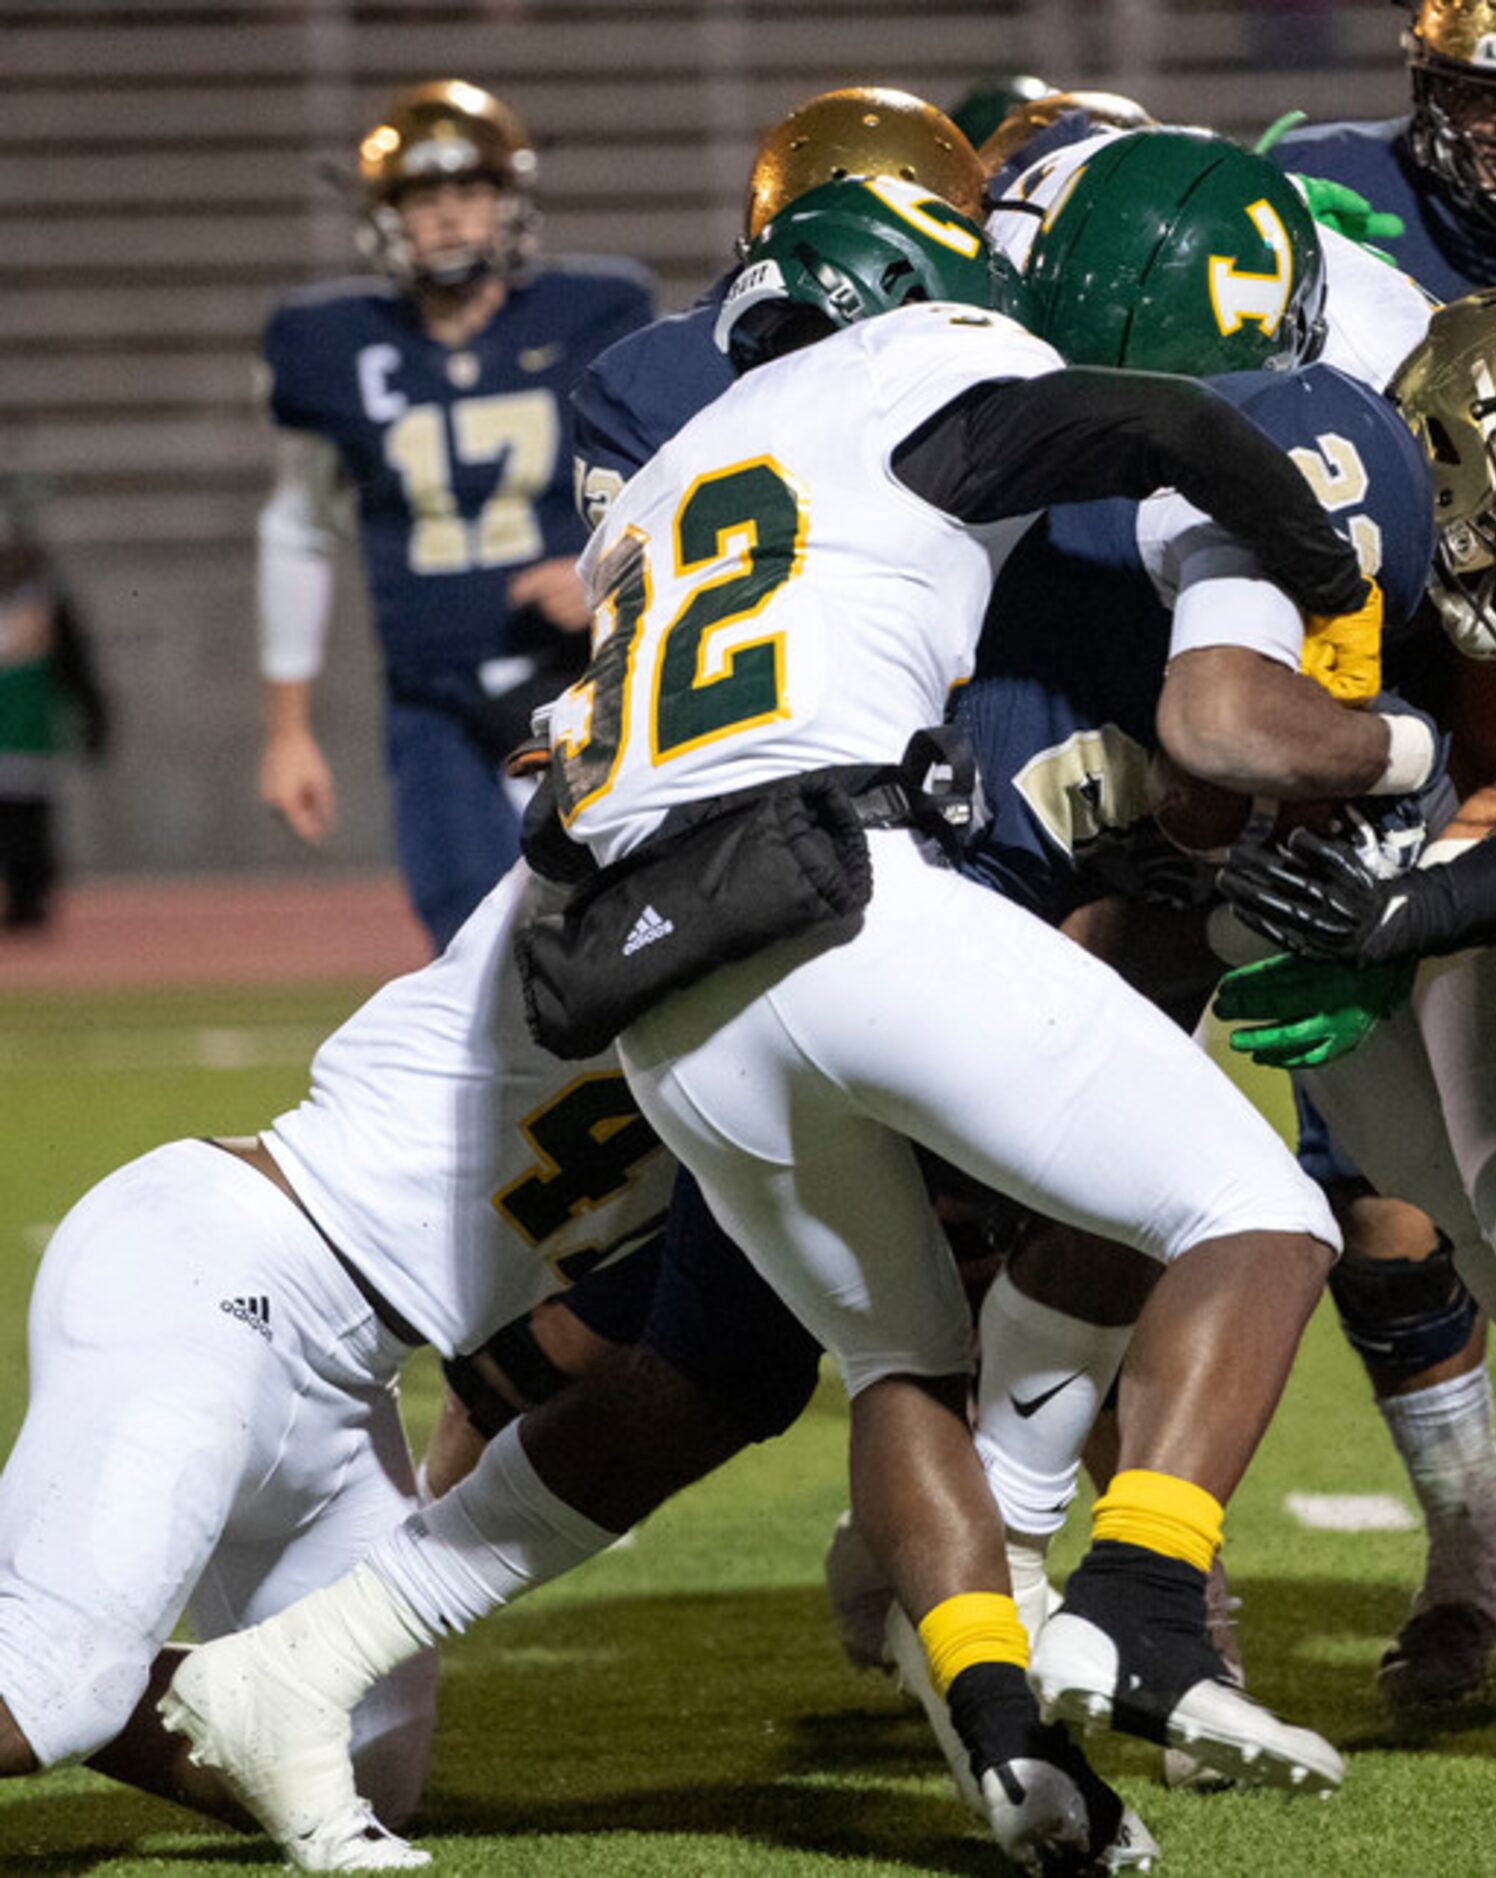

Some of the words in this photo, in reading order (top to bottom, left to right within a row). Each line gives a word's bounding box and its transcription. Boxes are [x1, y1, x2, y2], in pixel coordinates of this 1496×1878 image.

[1208, 197, 1313, 337] L
[357, 343, 408, 424] C
[383, 387, 562, 577] 17
